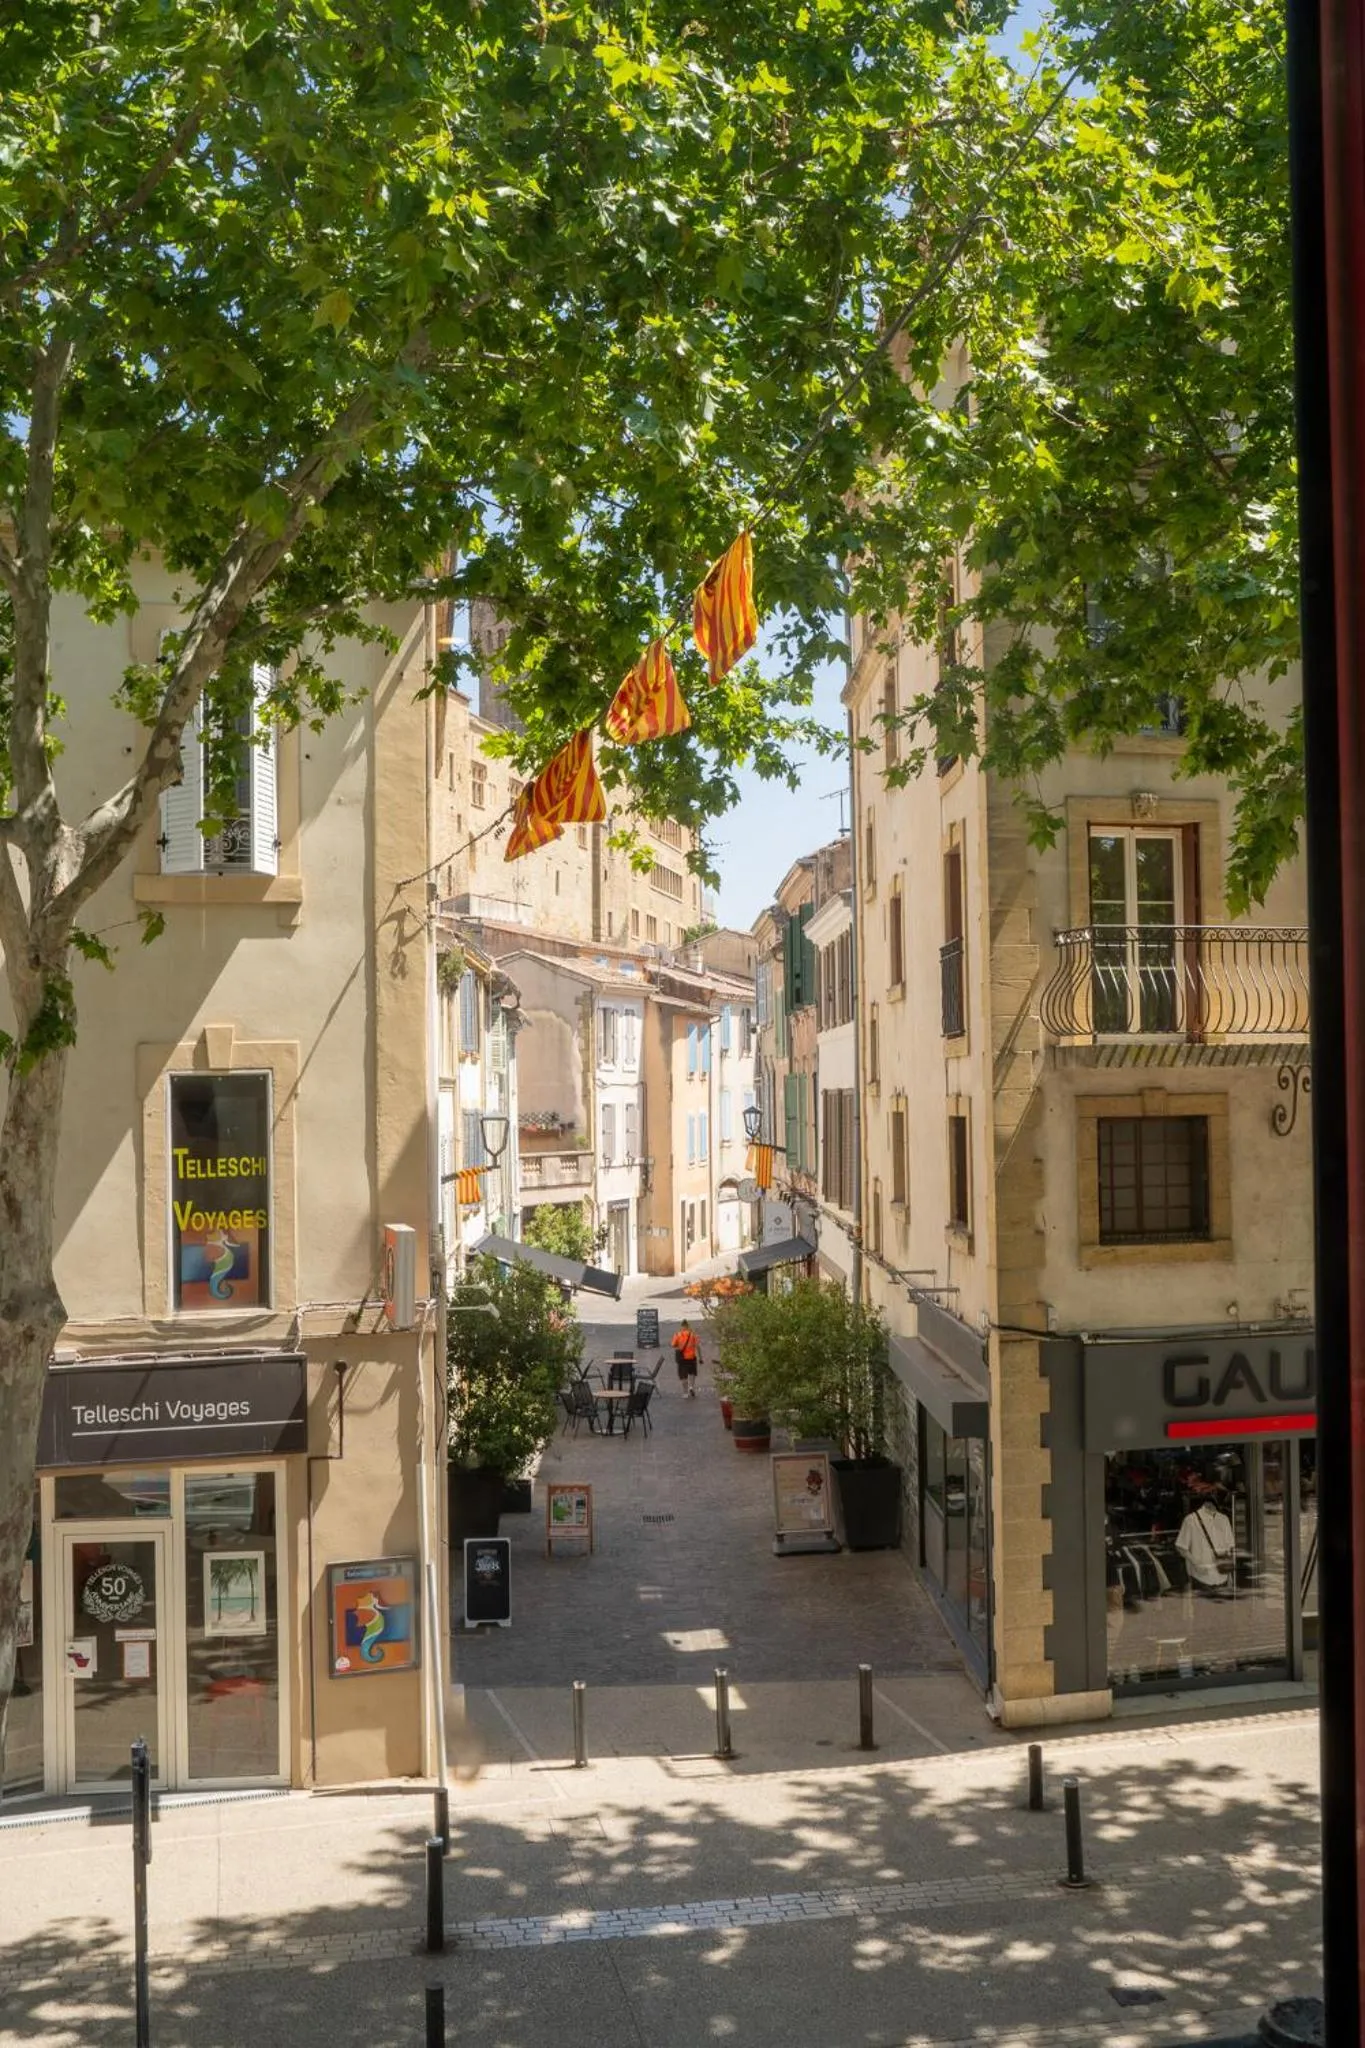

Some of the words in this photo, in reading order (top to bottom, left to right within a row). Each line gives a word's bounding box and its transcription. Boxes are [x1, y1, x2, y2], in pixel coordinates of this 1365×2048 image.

[173, 1147, 267, 1179] TELLESCHI
[173, 1200, 268, 1232] VOYAGES
[72, 1401, 160, 1425] Telleschi
[166, 1400, 251, 1420] Voyages
